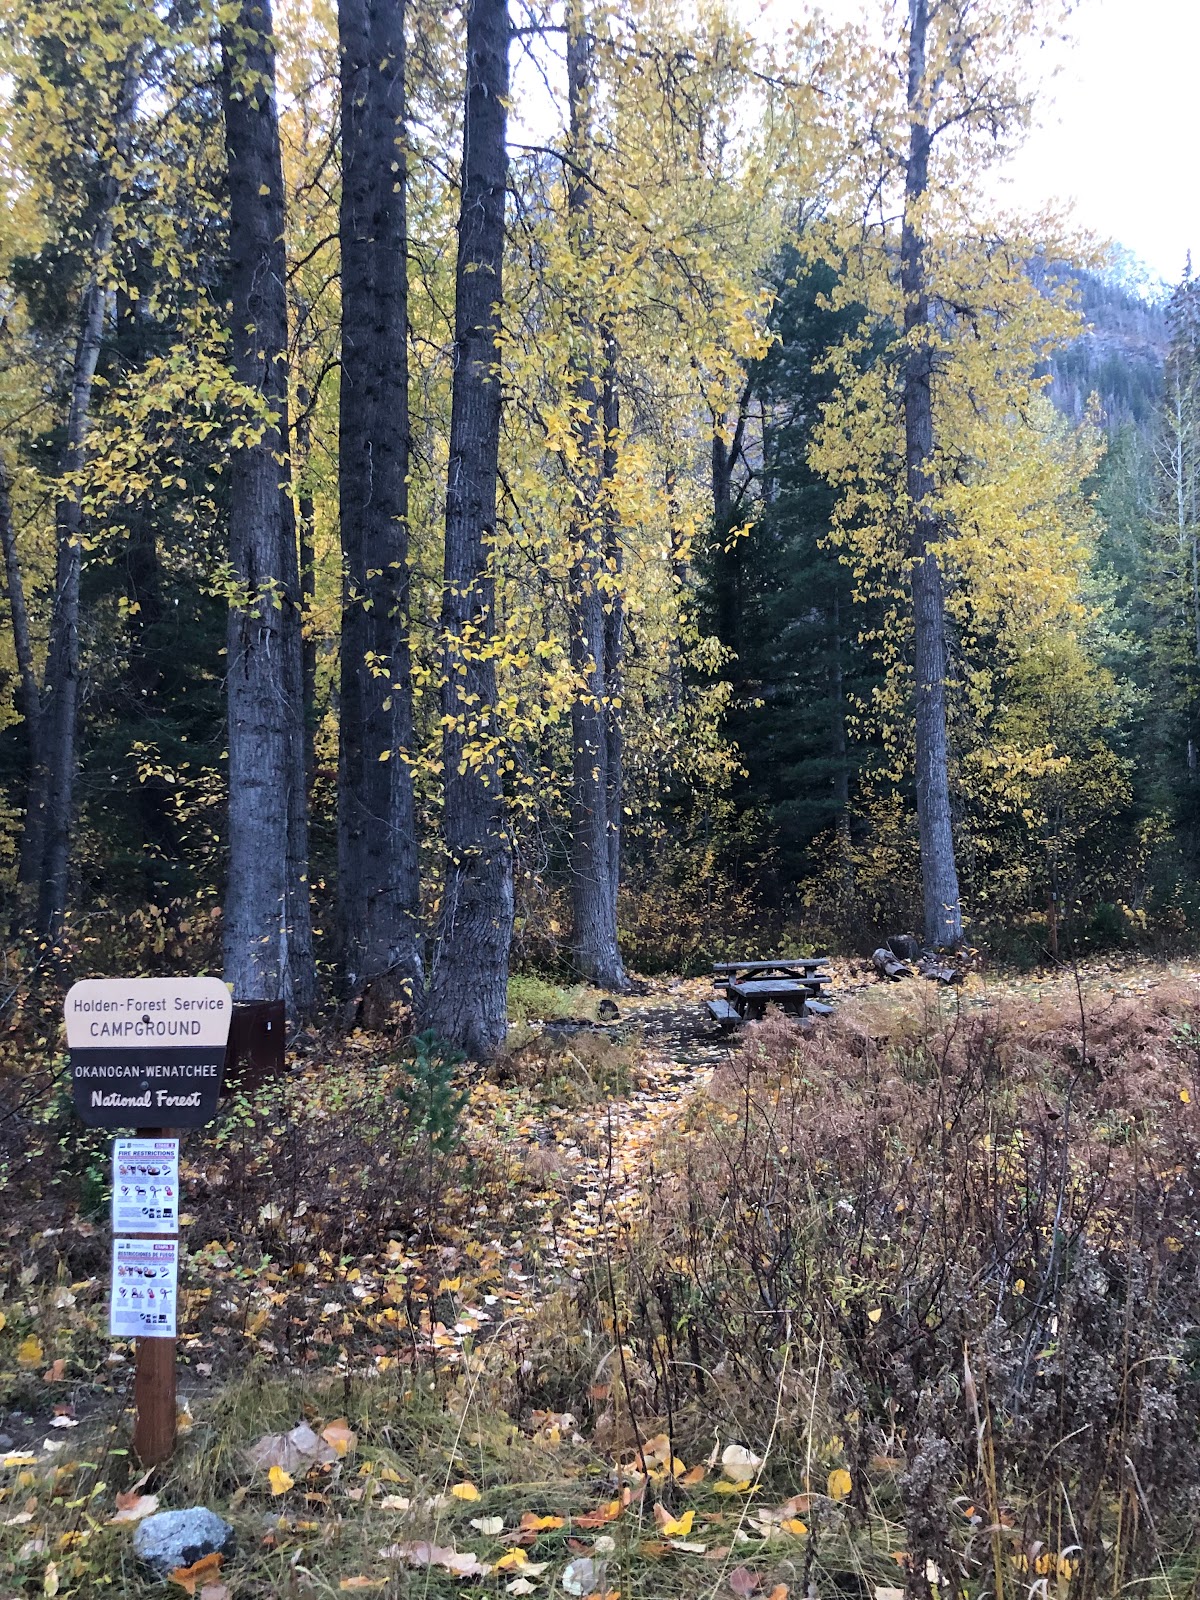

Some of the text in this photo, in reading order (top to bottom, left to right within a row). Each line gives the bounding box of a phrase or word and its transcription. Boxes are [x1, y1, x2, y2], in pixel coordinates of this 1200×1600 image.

[74, 997, 224, 1012] Holden-Forest Service
[90, 1020, 201, 1037] CAMPGROUND
[75, 1065, 218, 1078] OKANOGAN-WENATCHEE
[91, 1090, 202, 1107] National Forest
